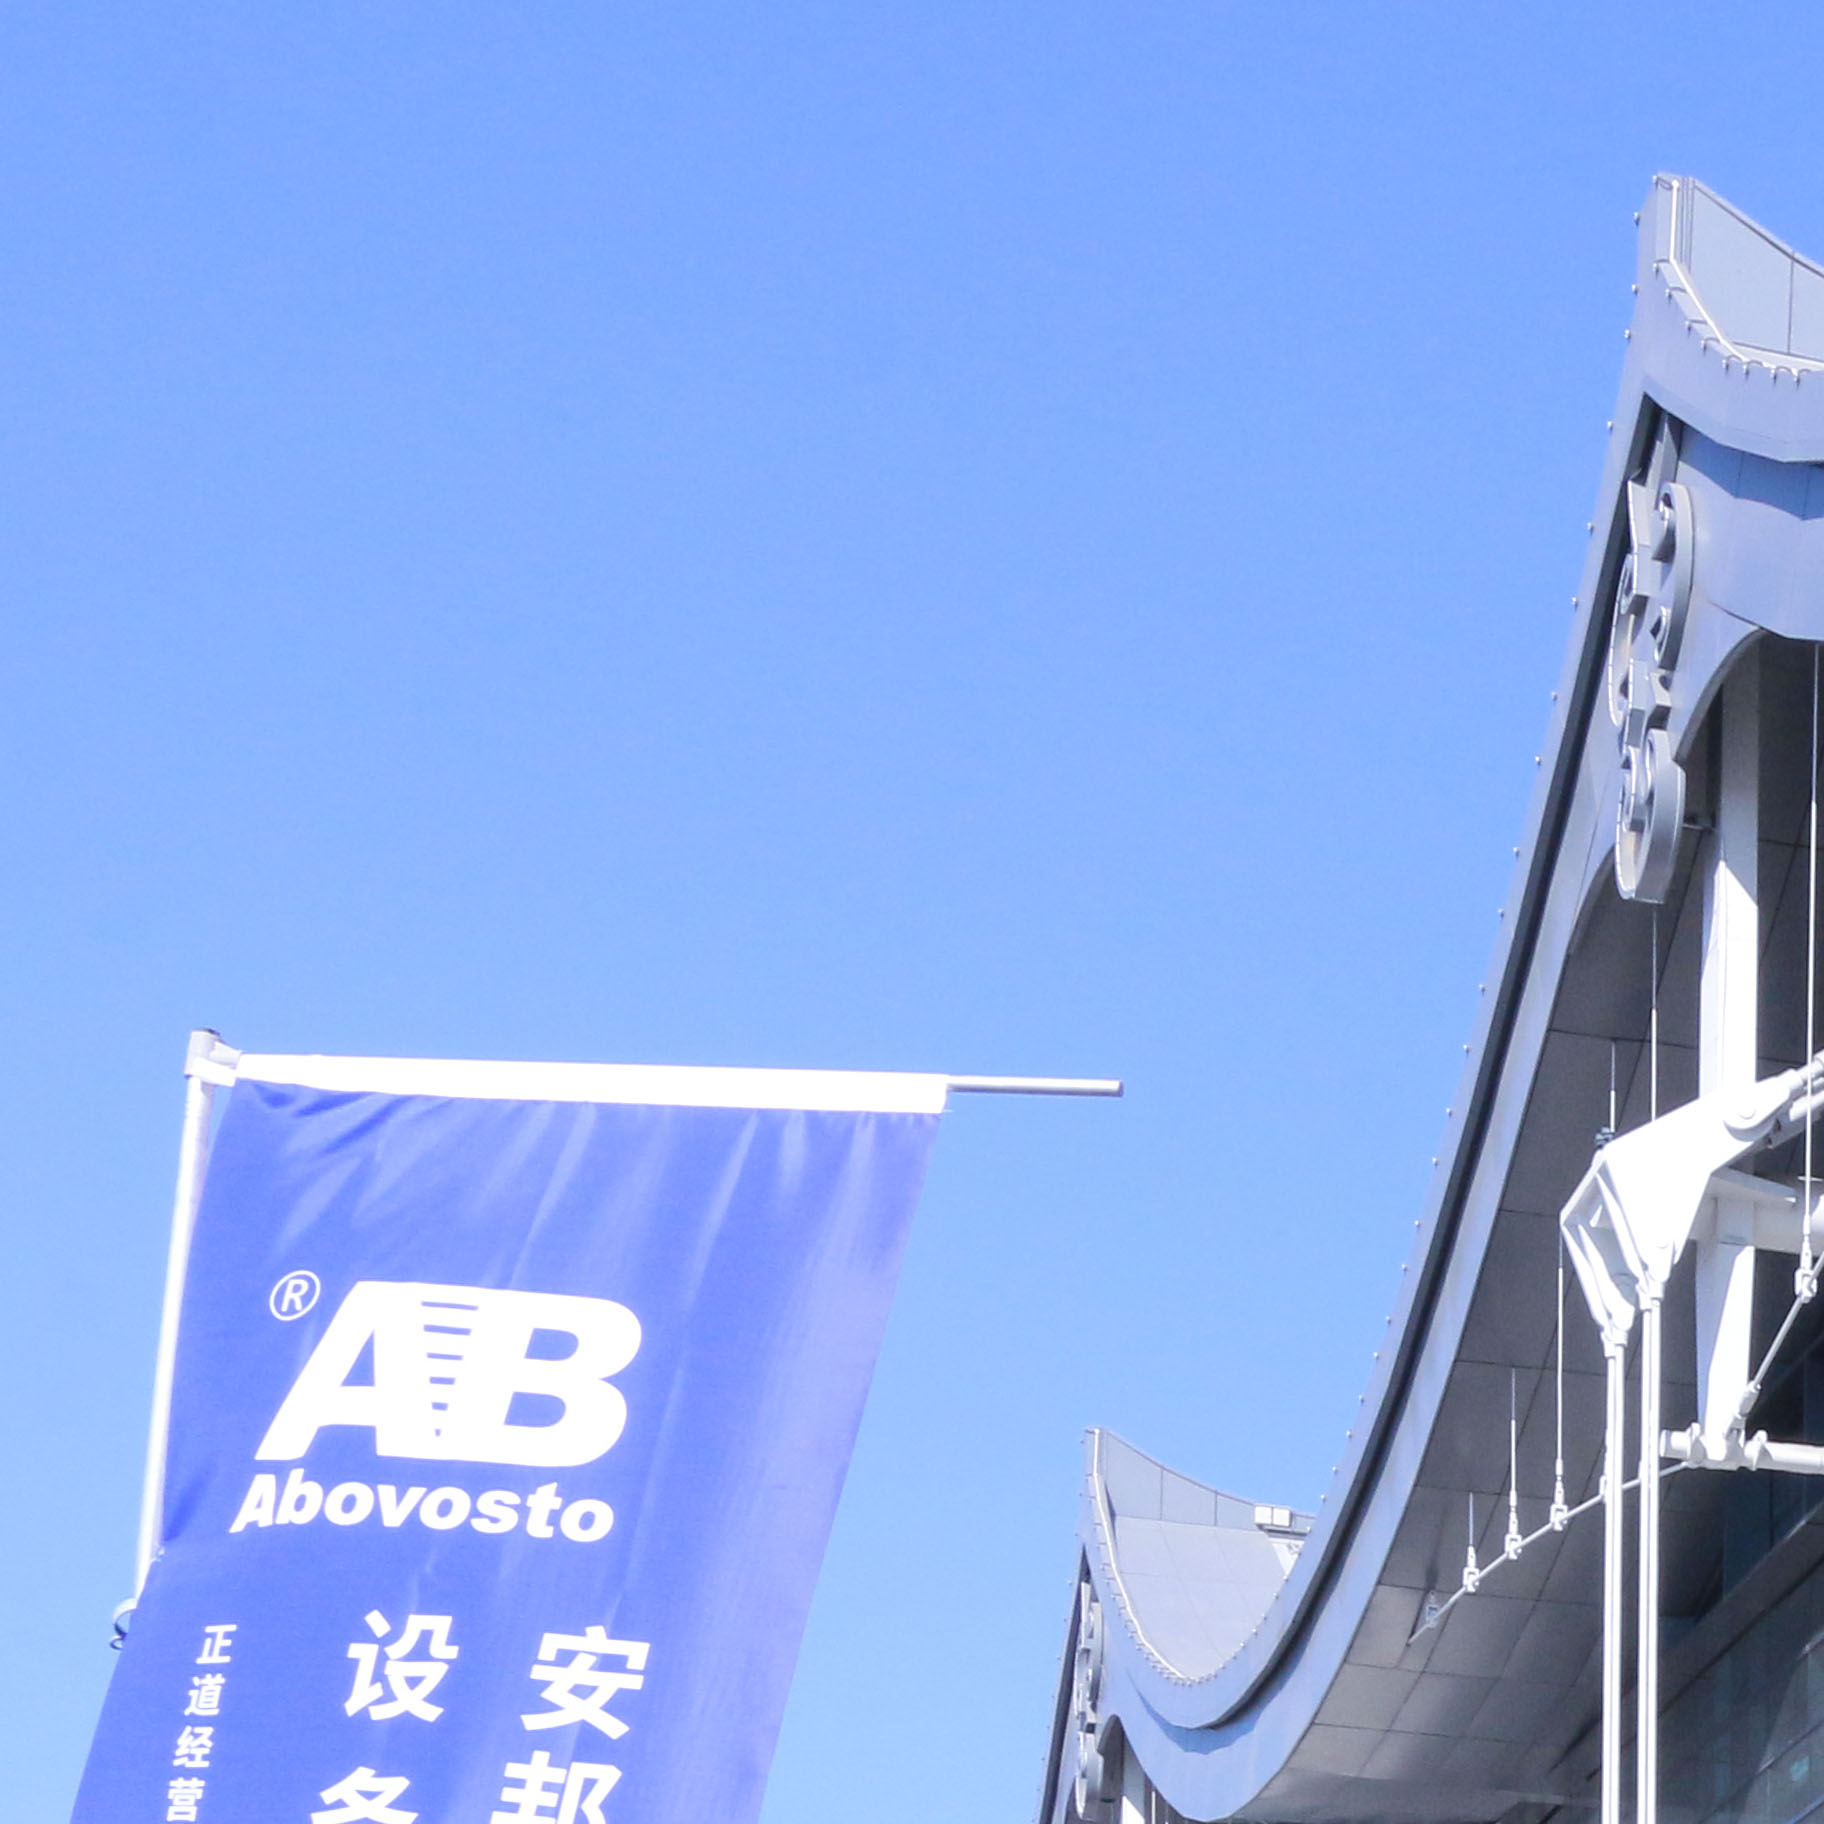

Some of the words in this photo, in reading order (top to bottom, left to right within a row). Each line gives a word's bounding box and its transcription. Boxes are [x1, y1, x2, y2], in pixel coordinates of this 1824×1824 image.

[229, 1467, 615, 1542] Abovosto
[165, 1623, 237, 1824] 正道经营
